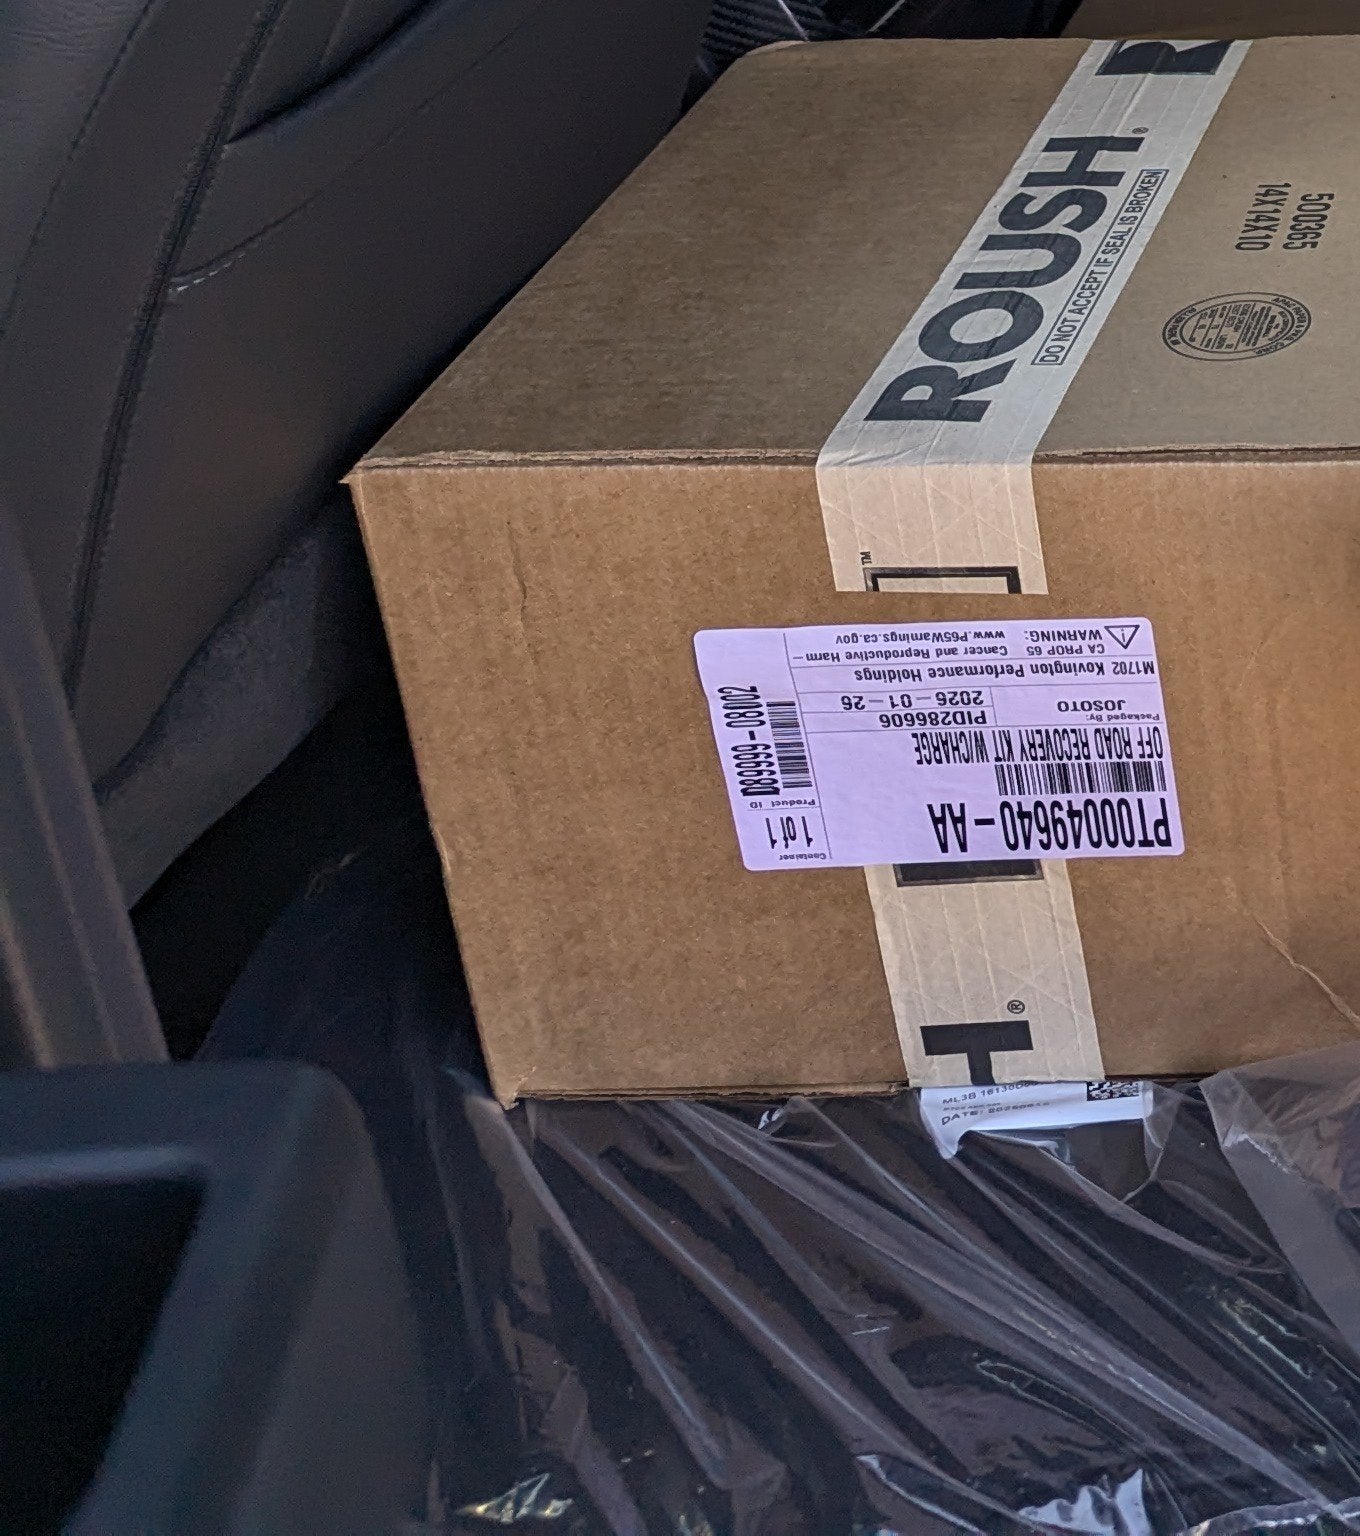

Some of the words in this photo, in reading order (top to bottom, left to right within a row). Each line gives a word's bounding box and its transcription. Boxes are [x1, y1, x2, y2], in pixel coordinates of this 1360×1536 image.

[1124, 170, 1163, 213] BROKEN
[1118, 215, 1138, 227] IS
[1235, 182, 1292, 251] 14X14X10
[1282, 193, 1335, 250] 500365
[1101, 228, 1131, 255] SEAL
[1095, 257, 1114, 267] IF
[863, 136, 1145, 422] ROUSH
[1068, 269, 1109, 316] ACCEPT
[1051, 319, 1081, 342] NOT
[1039, 340, 1064, 363] DO
[859, 550, 873, 566] TM
[835, 630, 1005, 645] www.P65Warnings.ca.gov
[1023, 629, 1103, 643] WARNING:
[806, 652, 840, 662] Harm
[845, 648, 930, 661] Reproductive
[935, 647, 958, 658] and
[963, 645, 1008, 656] Cancer
[1026, 646, 1042, 657] 65
[1047, 645, 1083, 656] PROP
[1088, 643, 1105, 654] CA
[854, 668, 922, 683] Holdings
[927, 663, 1025, 680] Performance
[1029, 660, 1105, 677] Kovington
[1111, 661, 1155, 675] M1702
[1057, 699, 1126, 712] JOSOTO
[878, 710, 987, 728] PID286606
[1085, 713, 1103, 722] By:
[1106, 713, 1160, 722] Packaged
[910, 730, 989, 765] W/CHARGE
[991, 729, 1013, 762] KIT
[1019, 728, 1088, 763] RECOVERY
[1093, 726, 1132, 761] ROAD
[1137, 725, 1163, 759] OFF
[771, 799, 815, 807] Product
[765, 818, 777, 850] 1
[779, 816, 797, 849] of
[801, 816, 813, 848] 1
[927, 798, 1172, 854] PT00049640-AA
[779, 853, 826, 861] Container
